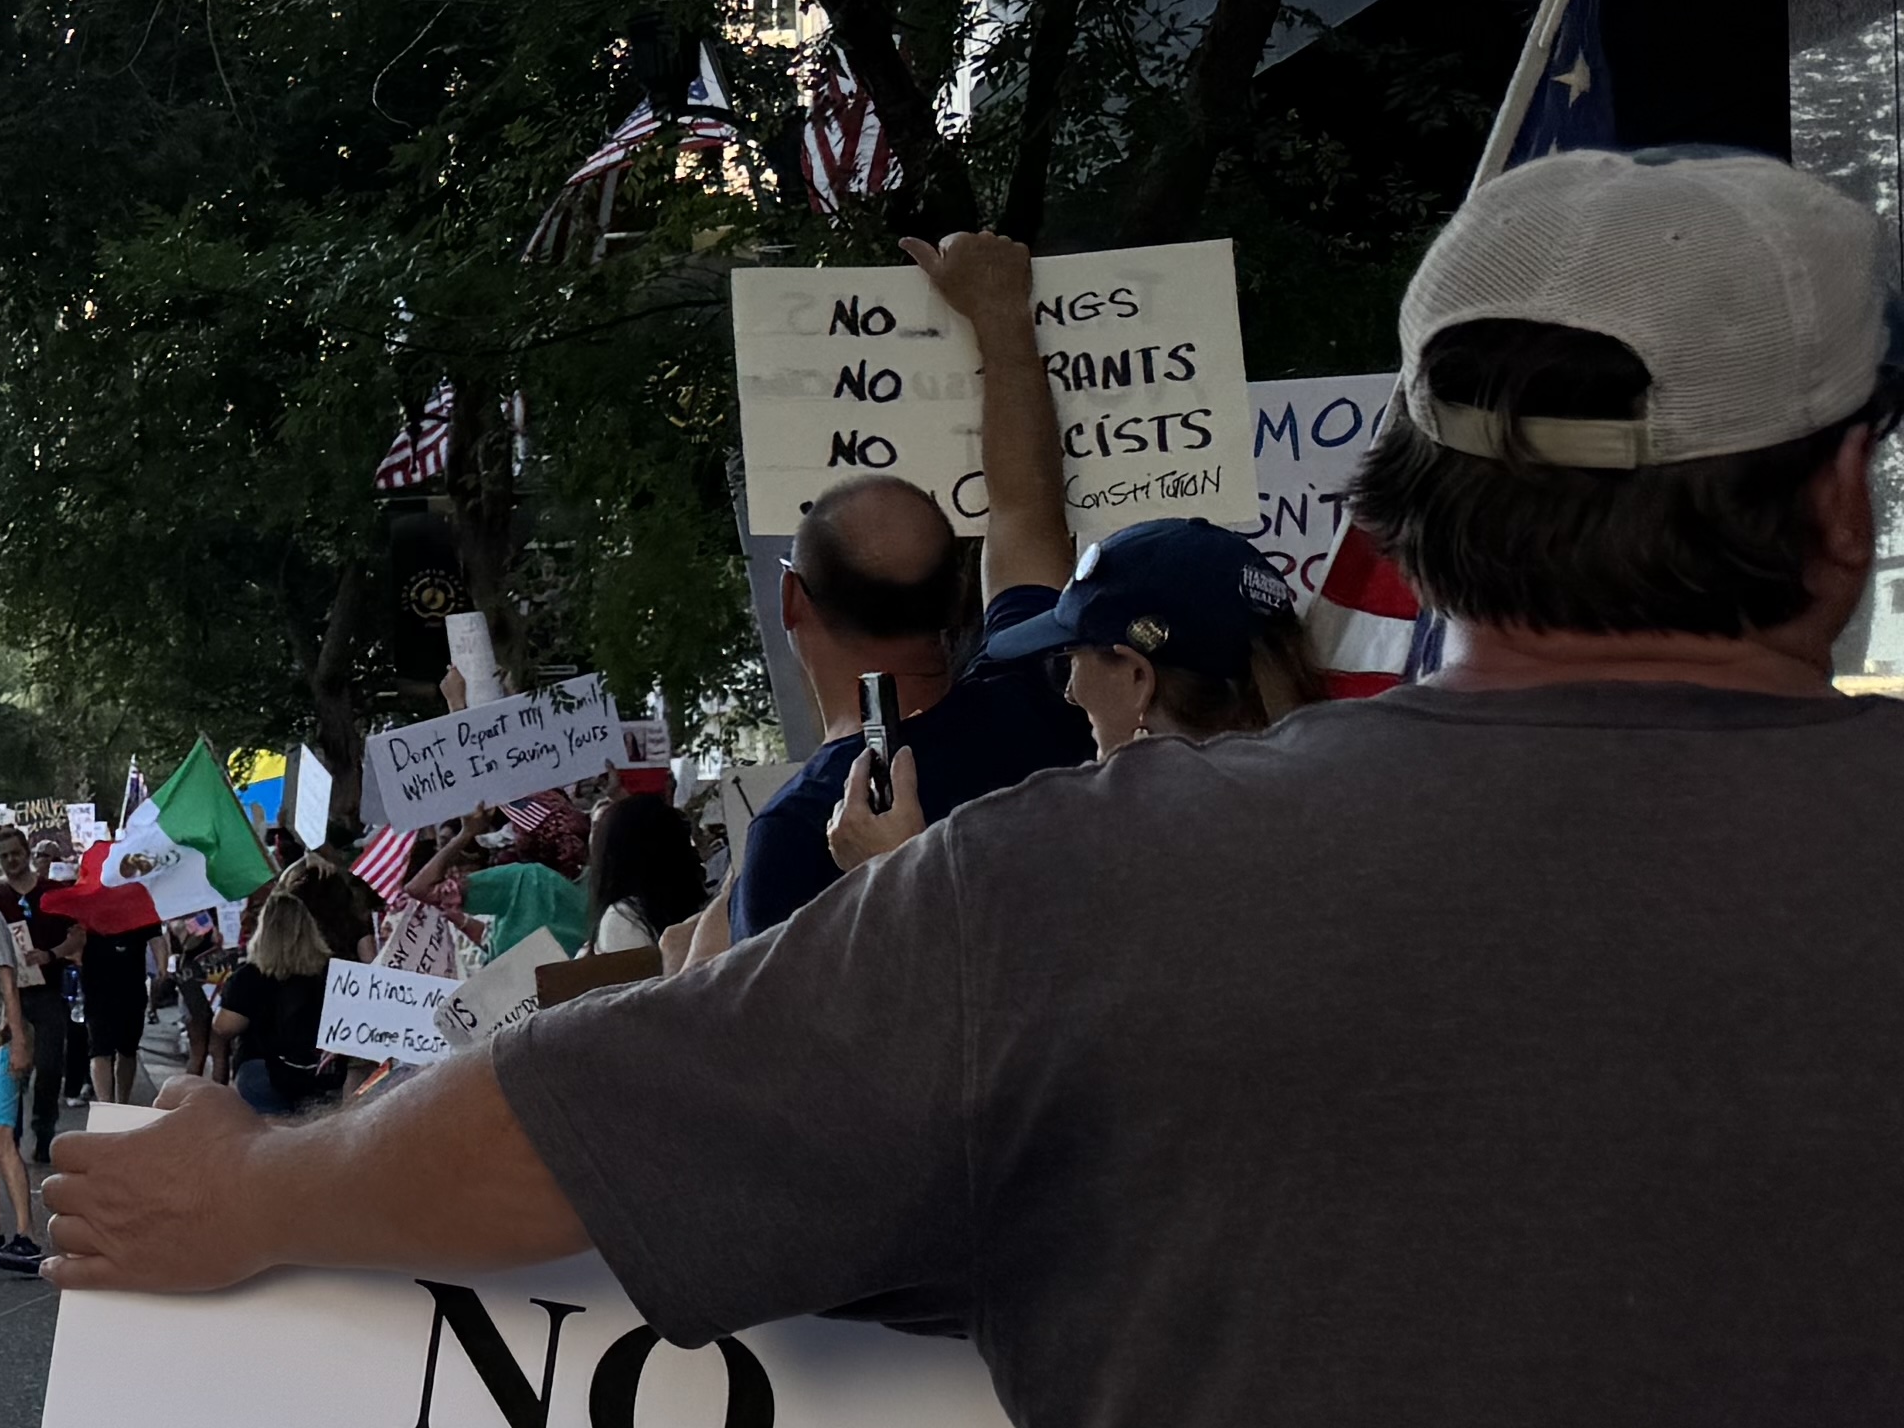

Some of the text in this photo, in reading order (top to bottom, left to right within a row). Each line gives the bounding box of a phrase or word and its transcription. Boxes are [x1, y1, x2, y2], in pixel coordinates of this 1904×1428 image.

[829, 287, 1140, 337] NO NGS
[833, 342, 1197, 403] NO RANTS
[827, 429, 898, 469] NO
[563, 725, 608, 757] Yours
[331, 970, 360, 998] No
[325, 1018, 351, 1045] No
